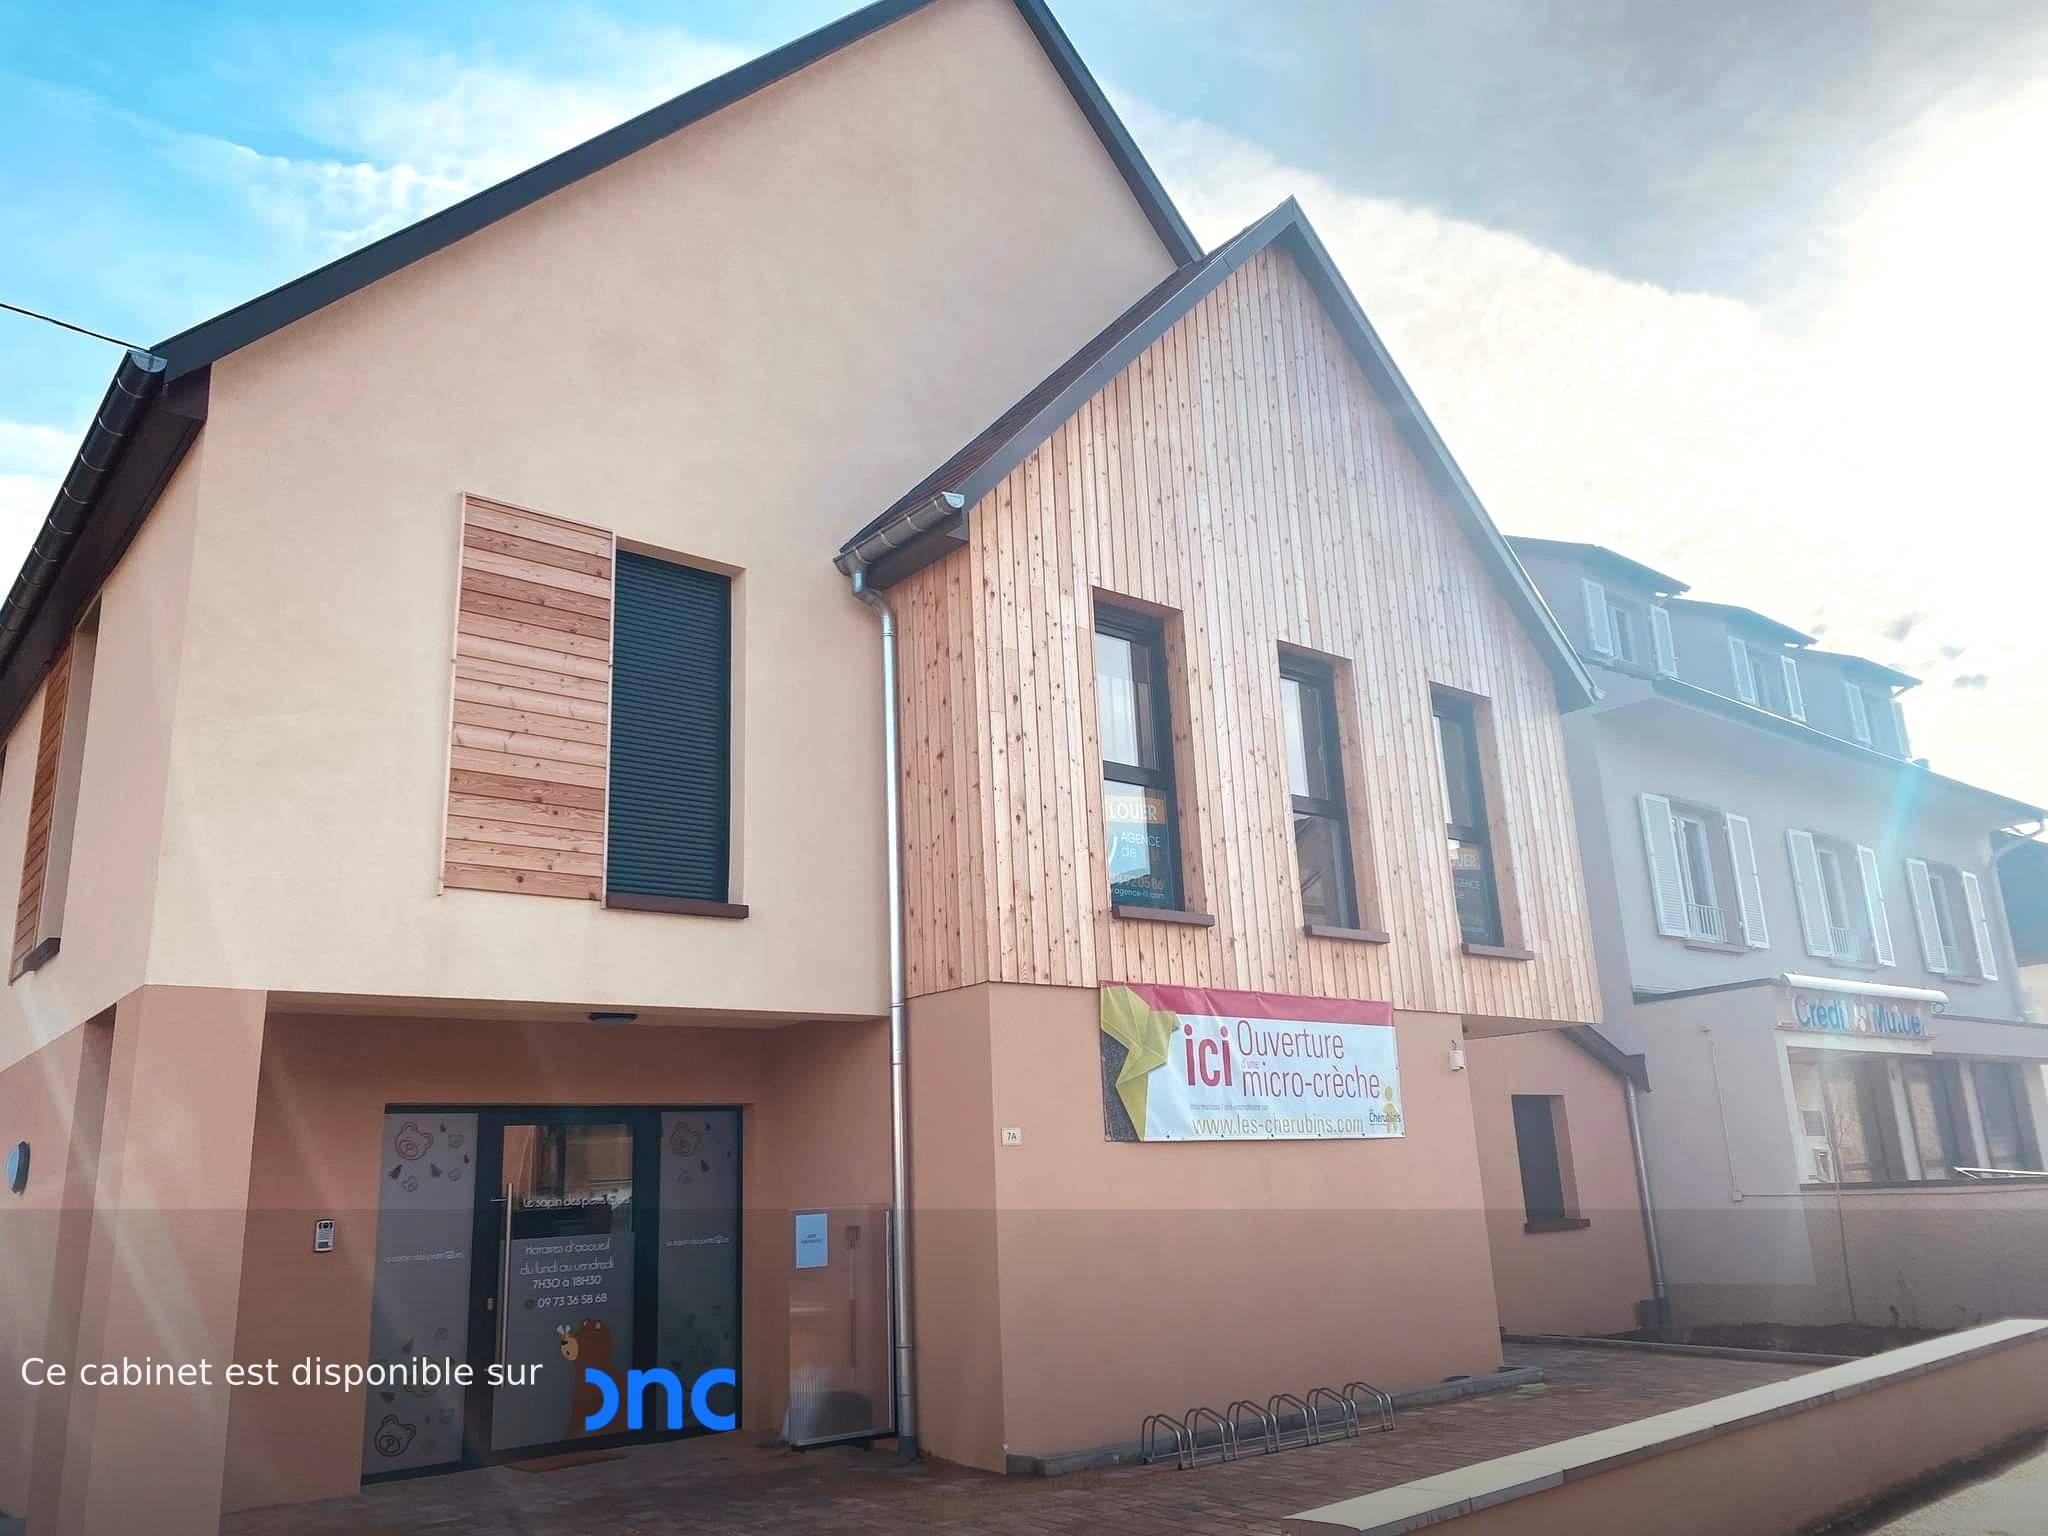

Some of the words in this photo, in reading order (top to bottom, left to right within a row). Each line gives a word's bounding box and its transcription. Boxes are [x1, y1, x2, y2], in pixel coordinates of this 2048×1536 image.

[1236, 1020, 1345, 1060] Ouverture
[1184, 1023, 1233, 1087] ici
[1242, 1063, 1381, 1099] micro-crèche
[1193, 1111, 1363, 1134] www.les-cherubins.com
[532, 1278, 561, 1289] 7H30
[571, 1275, 602, 1287] 18H30
[537, 1297, 551, 1308] 09
[552, 1296, 565, 1306] 73
[567, 1295, 579, 1305] 36
